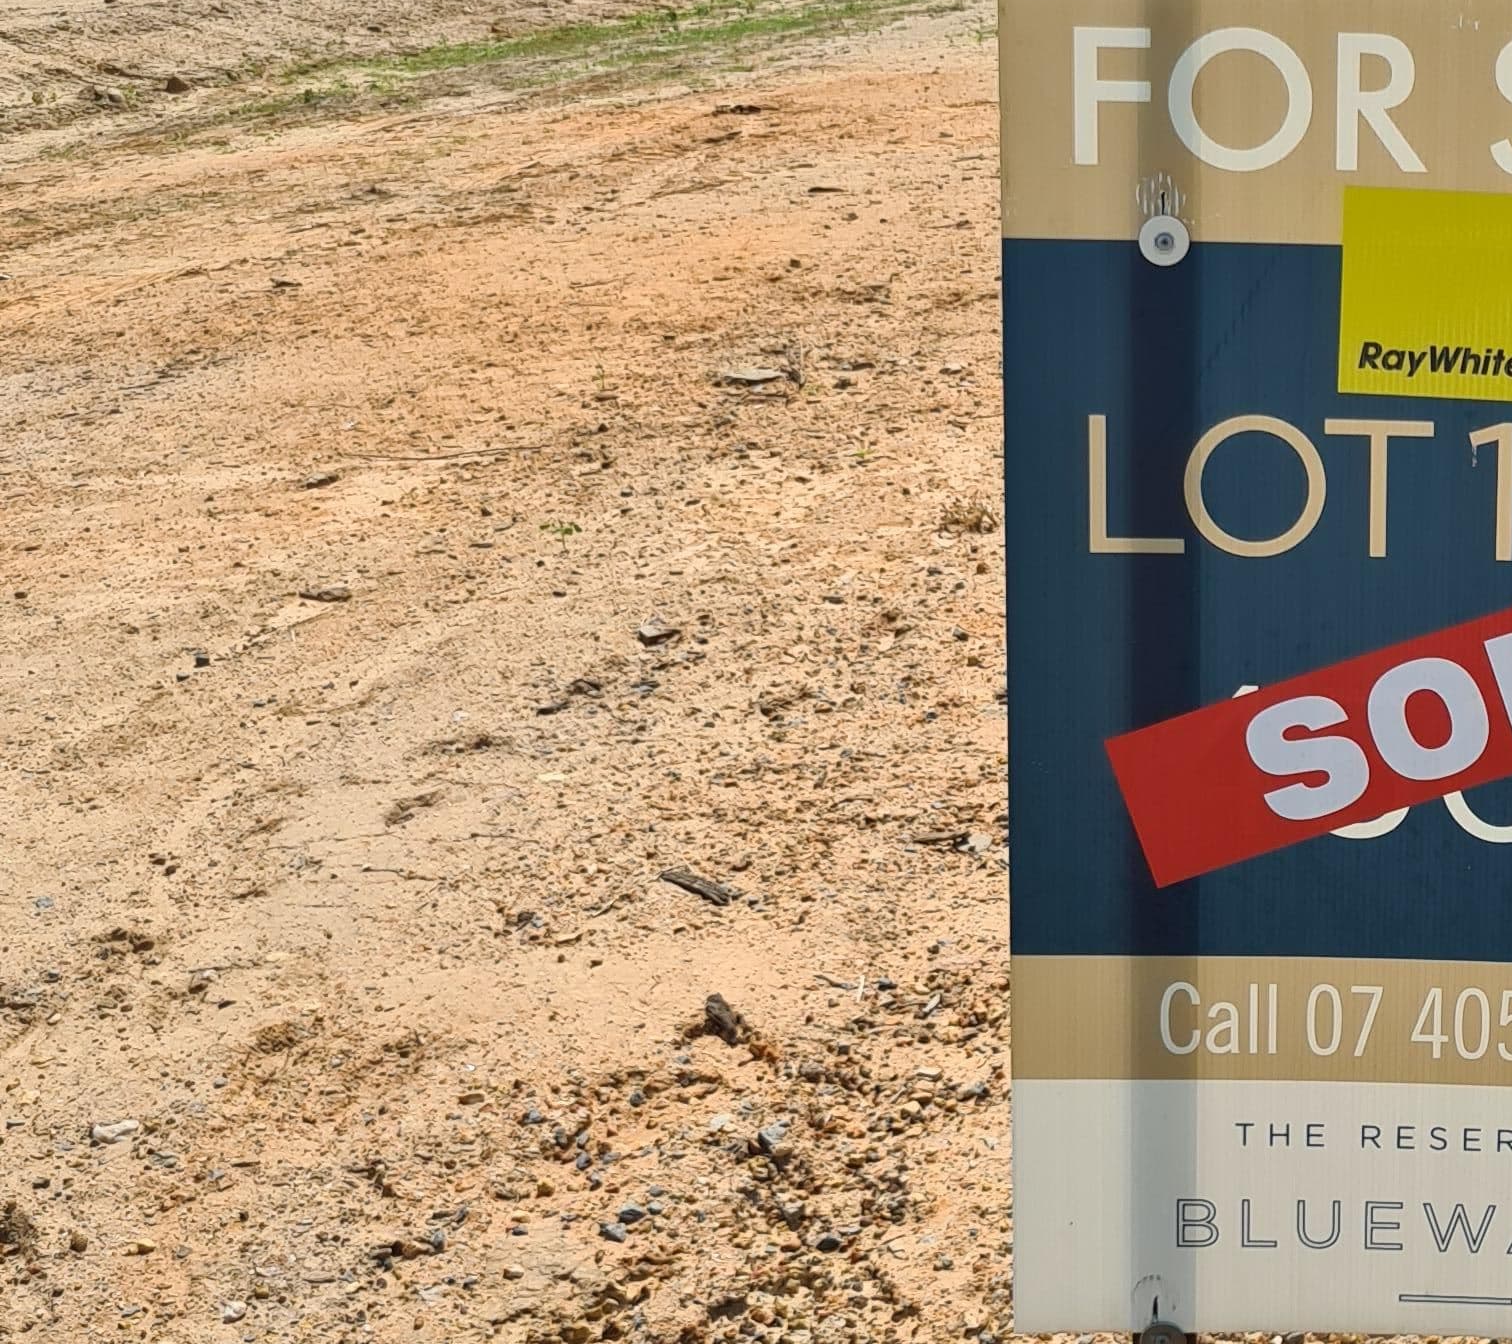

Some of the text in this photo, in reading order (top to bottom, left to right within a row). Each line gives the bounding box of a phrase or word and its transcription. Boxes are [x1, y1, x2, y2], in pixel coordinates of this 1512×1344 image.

[1073, 27, 1427, 173] FOR
[1088, 414, 1435, 558] LOT
[1160, 981, 1278, 1055] Call
[1305, 983, 1384, 1058] 07
[1236, 1122, 1326, 1148] THE
